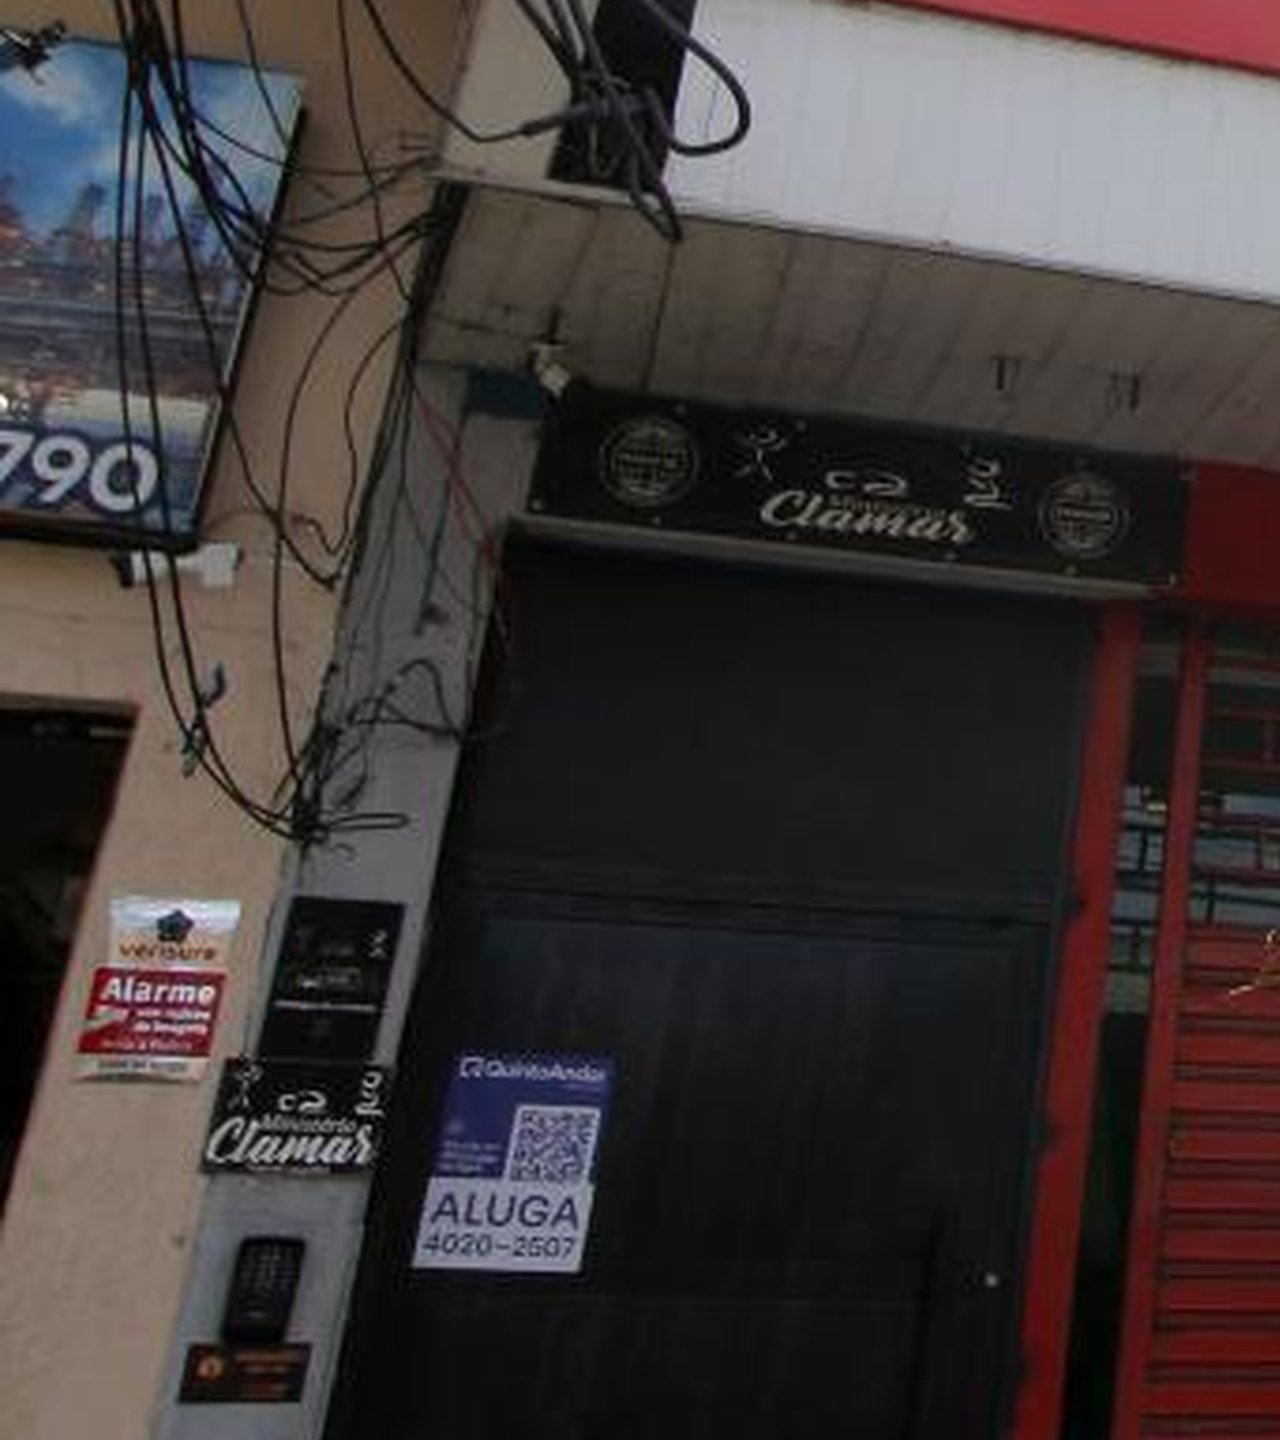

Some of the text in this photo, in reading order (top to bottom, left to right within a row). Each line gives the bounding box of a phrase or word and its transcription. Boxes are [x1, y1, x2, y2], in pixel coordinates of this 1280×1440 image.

[758, 488, 977, 546] Clamar
[100, 974, 218, 1007] Alarme
[204, 1114, 378, 1167] Clamar
[427, 1190, 580, 1232] ALUGA
